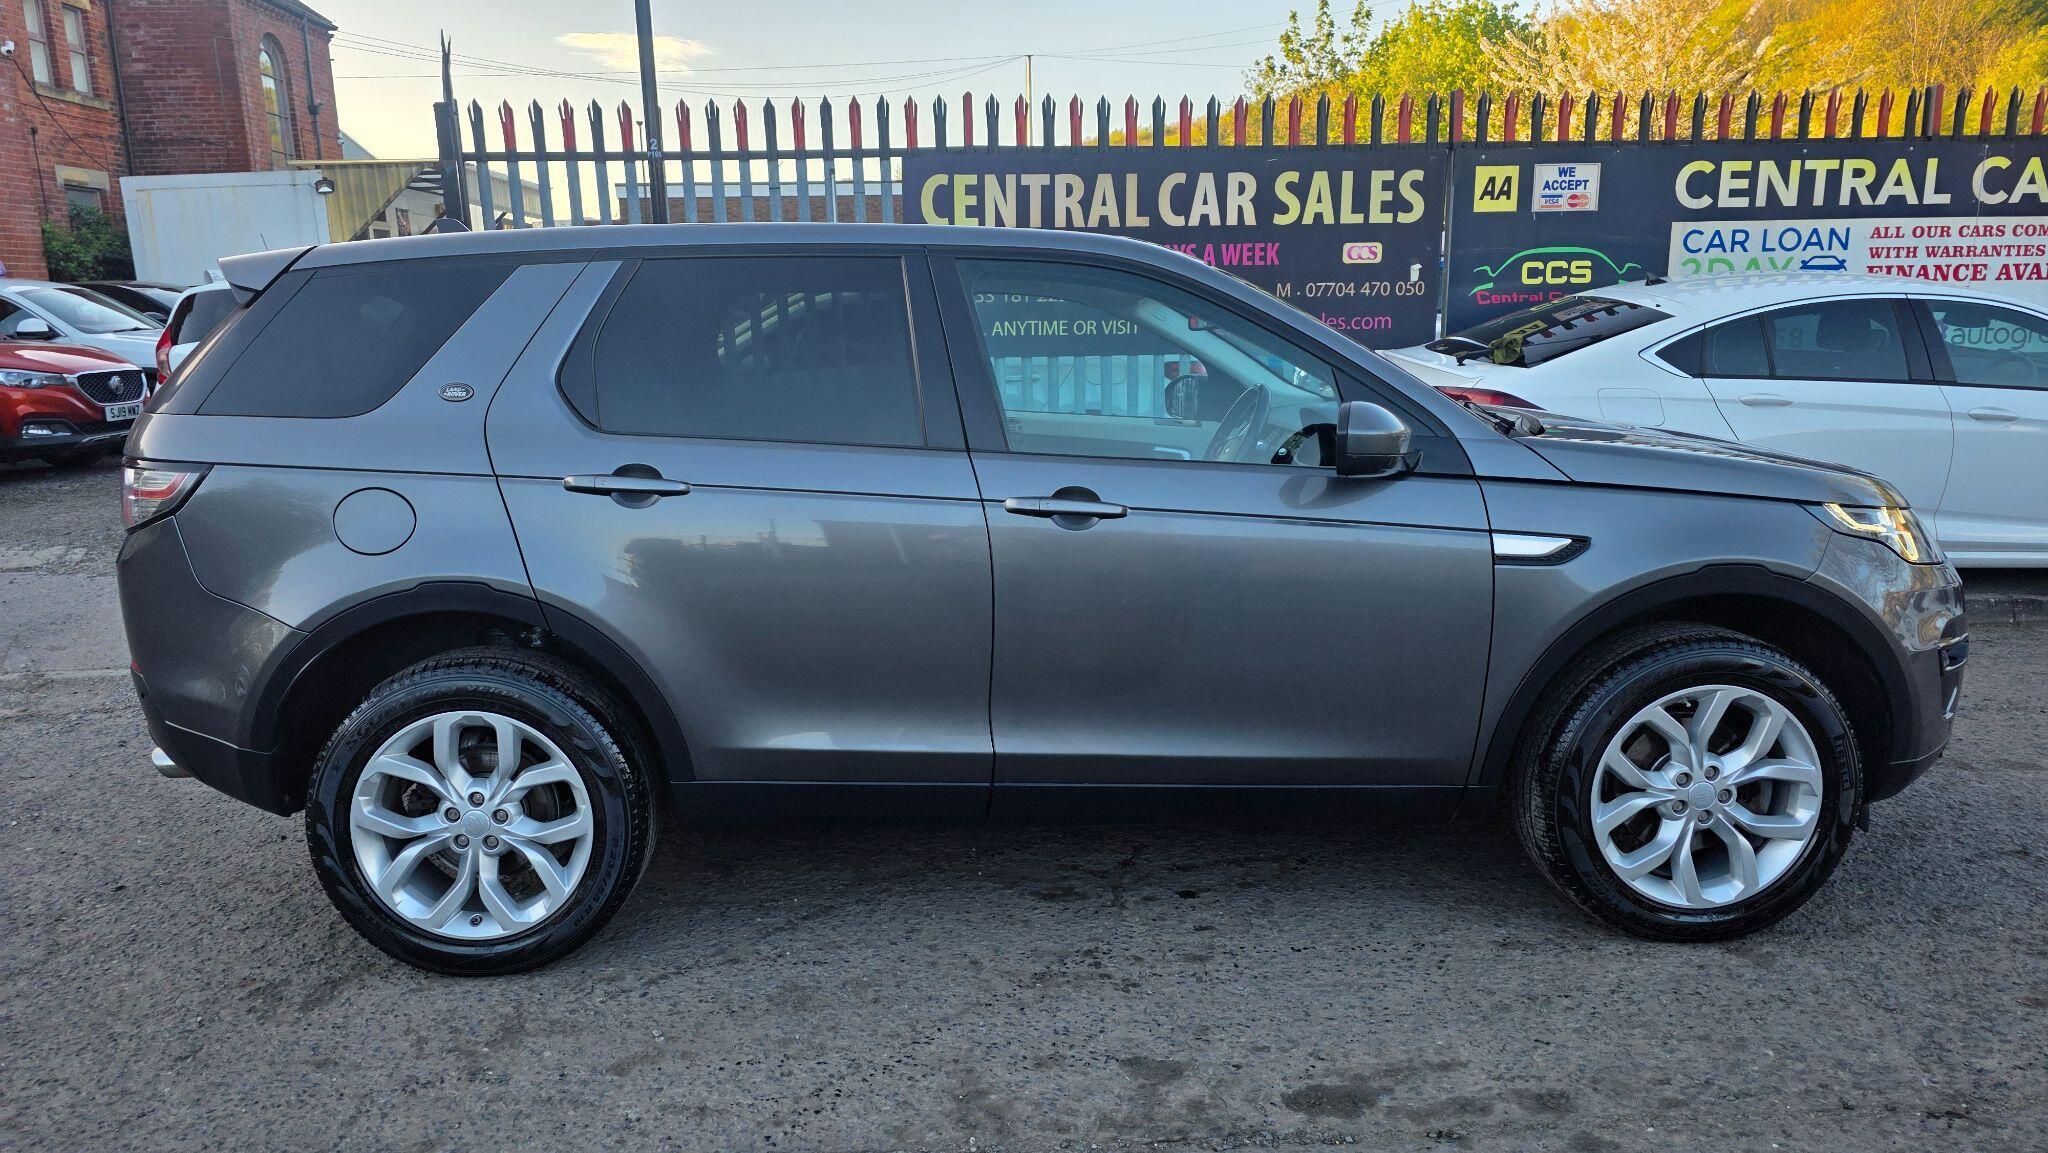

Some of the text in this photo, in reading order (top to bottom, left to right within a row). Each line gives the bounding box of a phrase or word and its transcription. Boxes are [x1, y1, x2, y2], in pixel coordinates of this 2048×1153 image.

[649, 138, 658, 150] 2
[1558, 166, 1577, 178] WE
[1478, 176, 1513, 200] AA
[1542, 180, 1590, 191] ACCEPT
[1675, 155, 2048, 210] CENTRAL CA
[920, 169, 1425, 228] CENTRAL CAR SALES
[1870, 226, 1906, 239] ALL
[1912, 225, 1952, 238] OUR
[1958, 224, 2006, 238] CARS
[1682, 226, 1851, 254] CAR LOAN
[1203, 243, 1216, 267] A
[1221, 242, 1280, 266] WEEK
[1346, 245, 1378, 260] CCS
[1868, 244, 2047, 259] WITH WARRANTIES
[1521, 260, 1592, 285] CCS
[1305, 282, 1356, 297] 07704
[1360, 282, 1390, 296] 470
[1396, 281, 1425, 296] 050
[1476, 291, 1543, 305] Central
[992, 320, 1068, 336] ANYTIME
[1073, 320, 1097, 335] OR
[110, 407, 126, 418] SJ19
